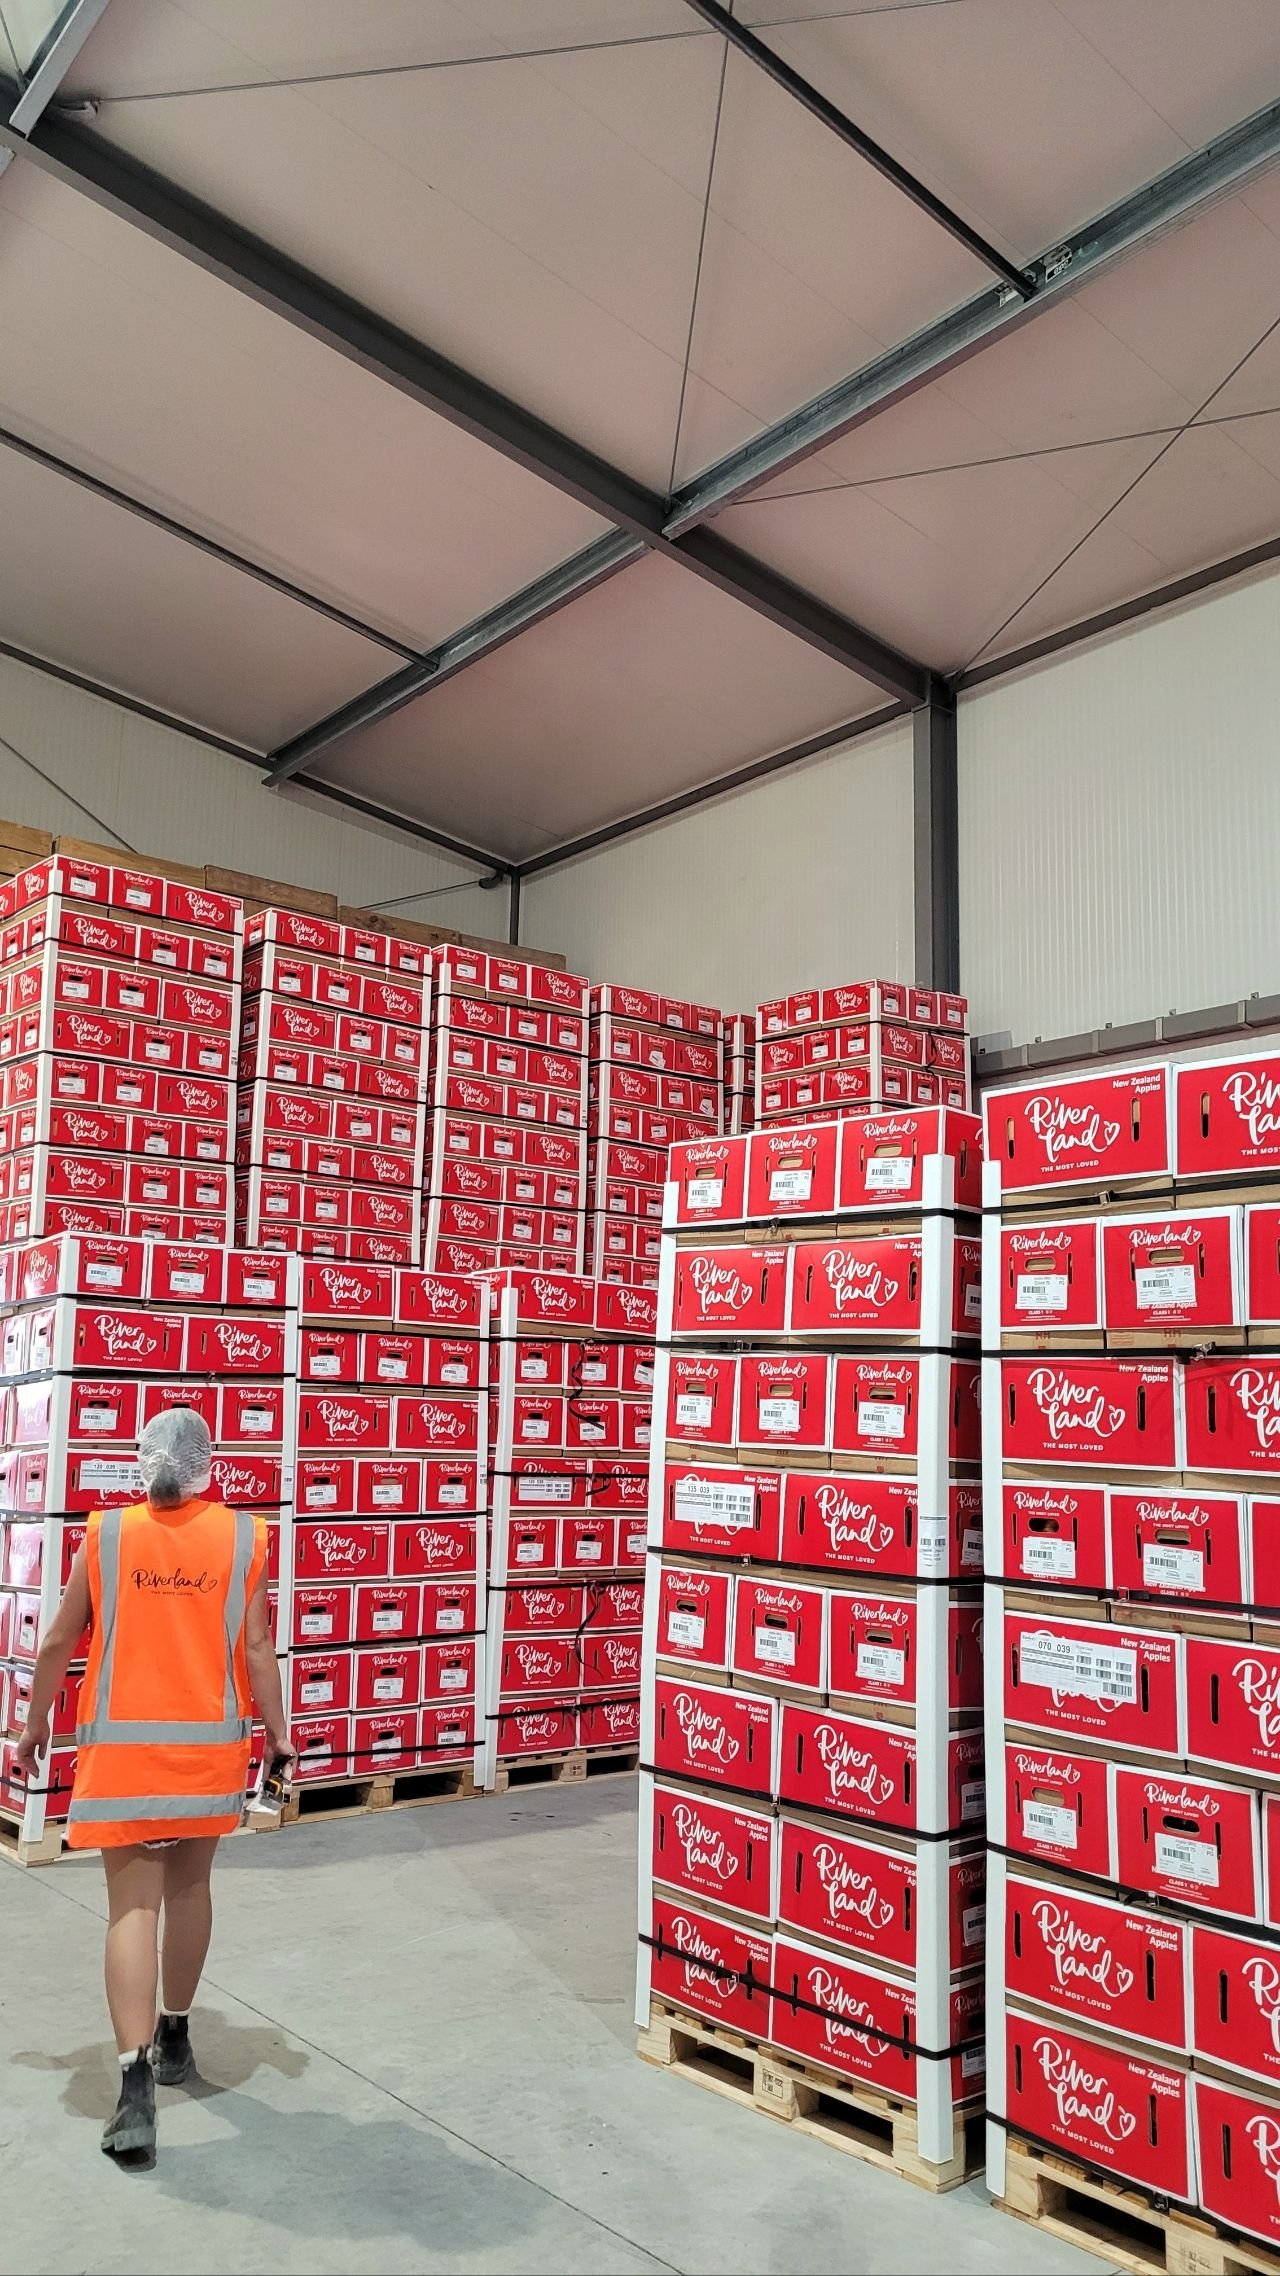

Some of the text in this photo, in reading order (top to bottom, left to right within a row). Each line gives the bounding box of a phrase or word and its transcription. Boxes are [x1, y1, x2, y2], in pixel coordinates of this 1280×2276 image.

[184, 892, 215, 911] River
[193, 904, 219, 922] land
[74, 918, 107, 937] River
[288, 918, 315, 934] River
[80, 930, 112, 948] land
[67, 1015, 102, 1034] River
[75, 1029, 106, 1045] land
[1113, 1074, 1160, 1089] New Zealand
[1135, 1083, 1160, 1094] Apples
[1222, 1072, 1280, 1112] Riv
[1024, 1096, 1095, 1133] River
[863, 1118, 910, 1138] Riverland
[1238, 1105, 1280, 1146] la
[768, 1134, 811, 1152] Riverland
[1038, 1114, 1108, 1163] land
[686, 1148, 724, 1162] Riverland
[1056, 1163, 1074, 1171] MOST
[1077, 1160, 1099, 1168] LOVED
[1010, 1231, 1065, 1252] Riverland
[1129, 1225, 1193, 1247] Riverland
[86, 1240, 122, 1255] Riverland
[168, 1248, 202, 1261] Riverland
[764, 1250, 784, 1258] Zealand
[242, 1256, 274, 1269] Riverland
[690, 1256, 736, 1287] River
[822, 1250, 876, 1282] River
[320, 1268, 358, 1289] River
[421, 1278, 456, 1298] River
[531, 1277, 564, 1295] River
[328, 1286, 365, 1304] land
[540, 1293, 570, 1309] land
[698, 1276, 742, 1312] land
[830, 1272, 884, 1310] land
[429, 1294, 462, 1313] land
[94, 1314, 141, 1338] River
[214, 1323, 257, 1347] River
[104, 1331, 149, 1357] land
[223, 1341, 263, 1362] land
[676, 1361, 714, 1378] Riverland
[758, 1360, 802, 1378] Riverland
[856, 1362, 905, 1383] Riverland
[1119, 1364, 1168, 1373] New Zealand
[1141, 1373, 1168, 1382] Apples
[78, 1384, 116, 1397] Riverland
[161, 1388, 198, 1400] Riverland
[238, 1390, 272, 1400] Riverland
[1027, 1368, 1099, 1405] River
[1040, 1395, 1112, 1440] land
[213, 1460, 251, 1482] River
[757, 1476, 778, 1484] Zealand
[219, 1476, 259, 1499] land
[759, 1484, 777, 1492] Apples
[889, 1487, 918, 1496] New Zeal
[815, 1485, 872, 1516] River
[1014, 1491, 1070, 1514] Riverland
[1136, 1502, 1202, 1526] Riverland
[824, 1516, 881, 1551] land
[838, 1554, 854, 1562] MOST
[856, 1556, 875, 1564] LOVED
[131, 1568, 208, 1593] Riverland
[667, 1574, 706, 1594] Riverland
[755, 1587, 798, 1609] Riverland
[851, 1603, 902, 1626] Riverland
[515, 1644, 550, 1664] River
[1038, 1640, 1070, 1653] 070 039
[1120, 1638, 1170, 1652] New Zealand
[1144, 1652, 1170, 1662] Apples
[522, 1657, 555, 1680] land
[673, 1692, 722, 1729] River
[736, 1703, 768, 1715] New Zealand
[750, 1712, 768, 1723] Apples
[1061, 1711, 1080, 1720] MOST
[1083, 1716, 1106, 1726] LOVED
[682, 1724, 731, 1762] land
[814, 1724, 872, 1768] River
[1252, 1748, 1268, 1757] THE
[694, 1760, 706, 1768] MOST
[708, 1765, 724, 1774] LOVED
[1014, 1754, 1074, 1784] Riverland
[824, 1762, 884, 1804] land
[1144, 1783, 1212, 1816] Riverland
[813, 1843, 872, 1891] River
[823, 1883, 884, 1928] land
[823, 1917, 874, 1940] THE MOST LOVED
[1032, 1900, 1105, 1953] River
[1126, 1919, 1178, 1941] New Zealand
[1150, 1936, 1178, 1952] Apples
[1046, 1943, 1121, 1997] land
[1050, 1984, 1112, 2010] THE MOST LOVED
[1032, 2037, 1107, 2094] River
[1128, 2062, 1180, 2088] New Zealand
[1152, 2080, 1180, 2098] Apples
[1048, 2081, 1122, 2140] land
[1052, 2123, 1114, 2155] THE MOST LOVED
